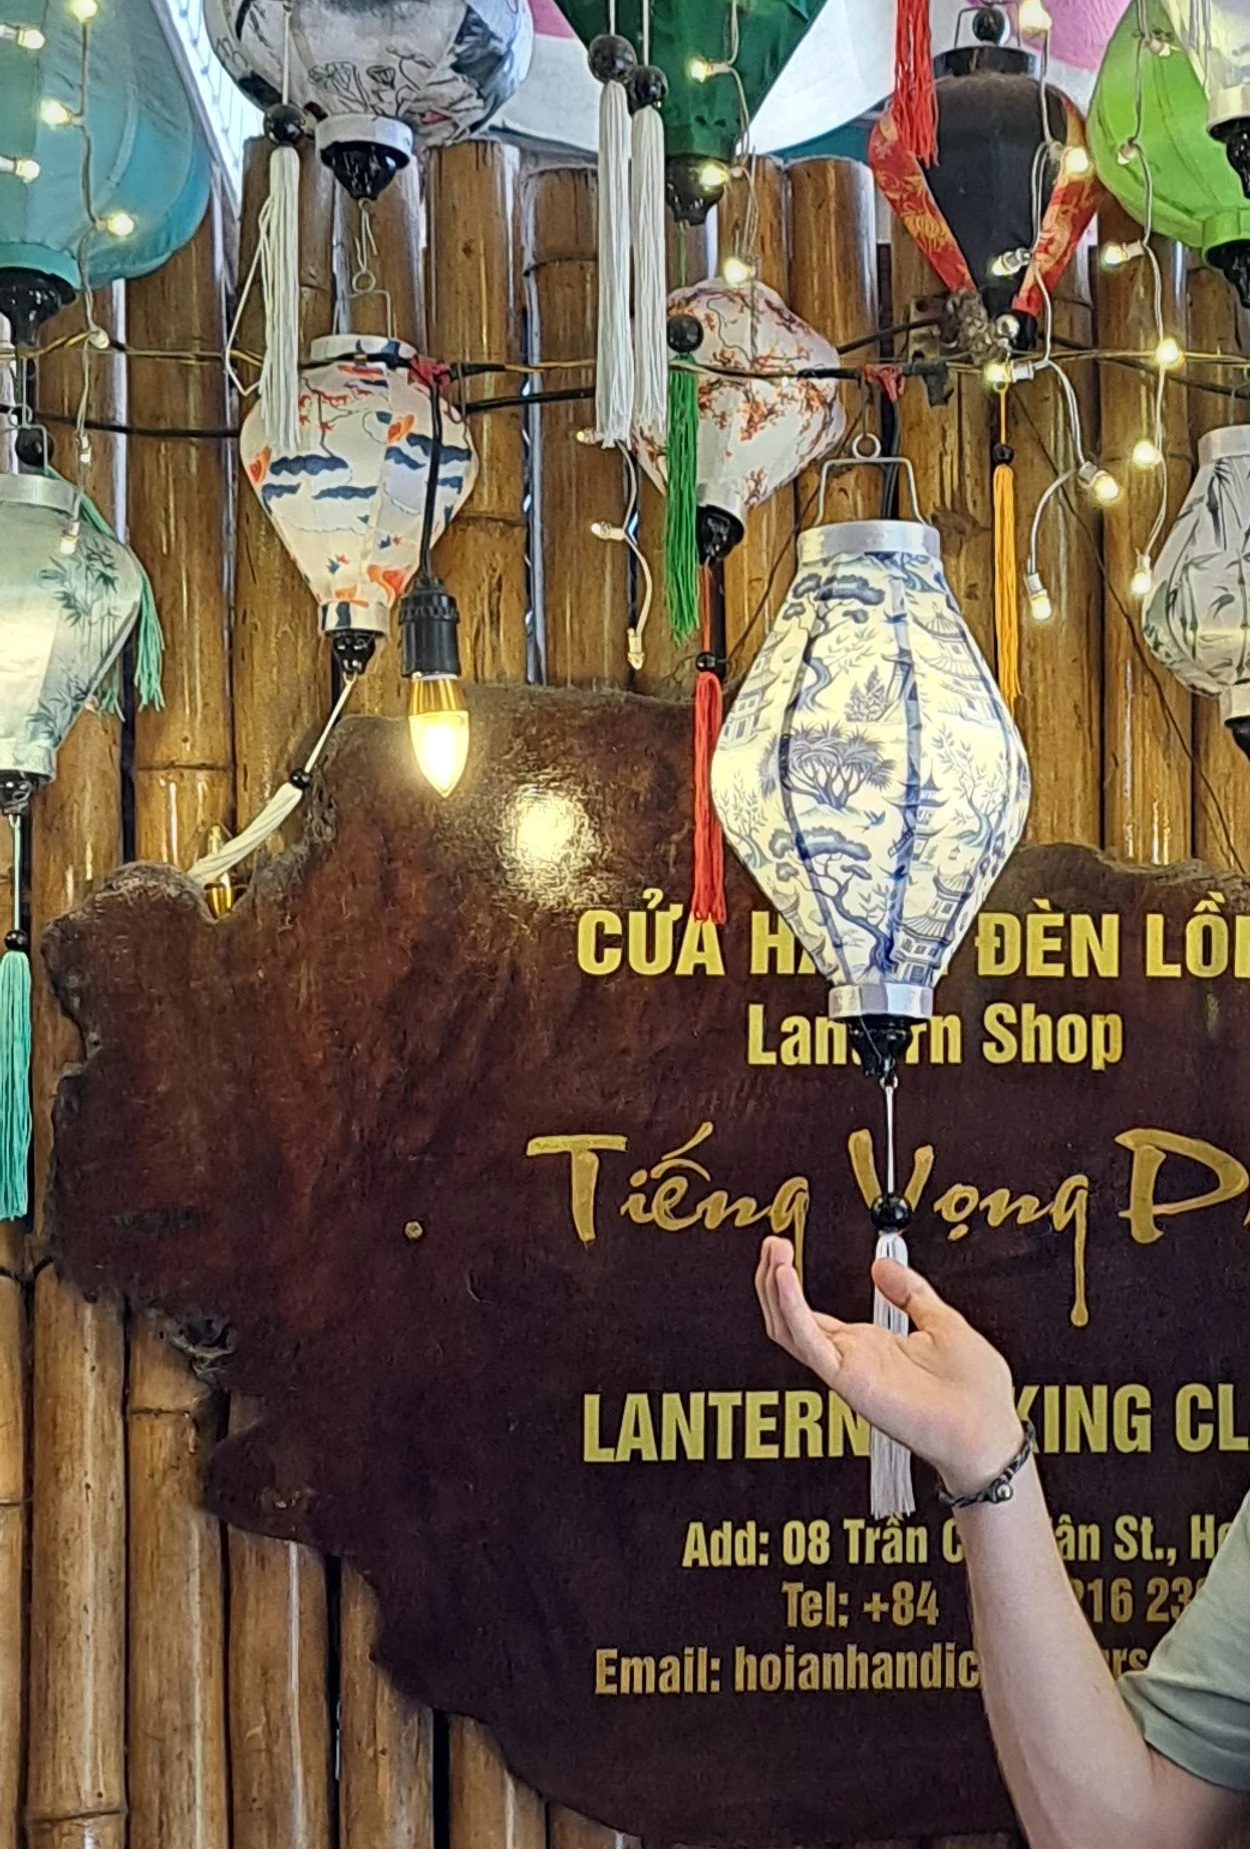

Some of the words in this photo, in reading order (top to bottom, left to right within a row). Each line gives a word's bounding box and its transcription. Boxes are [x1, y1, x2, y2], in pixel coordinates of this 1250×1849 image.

[577, 888, 725, 977] CỬA
[975, 898, 1119, 978] ĐÈN
[748, 1004, 962, 1066] Lanrn
[983, 1003, 1123, 1071] Shop
[527, 1121, 810, 1289] Tiếng
[583, 1390, 871, 1463] LANTERN
[682, 1520, 770, 1568] Add:
[782, 1519, 831, 1565] 08
[1114, 1515, 1177, 1567] St.,
[781, 1581, 849, 1628] Tel:
[862, 1580, 939, 1627] +84
[595, 1647, 721, 1695] Email:
